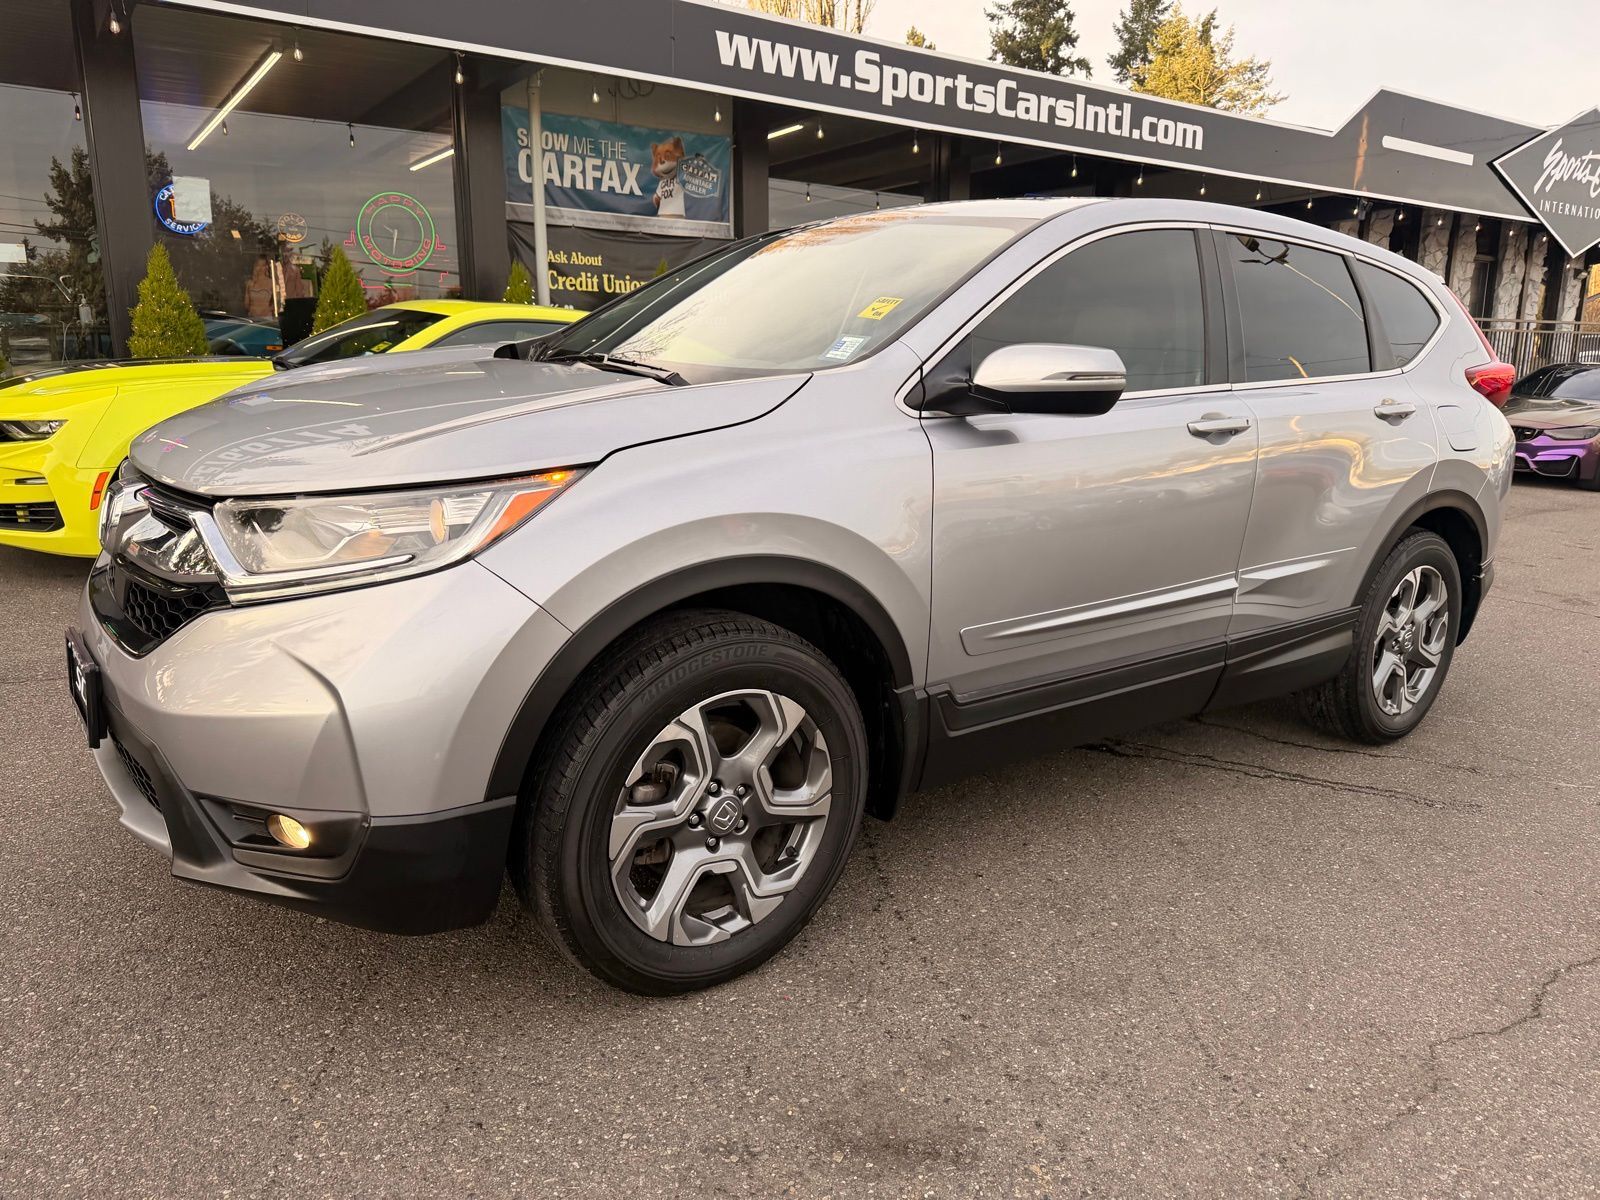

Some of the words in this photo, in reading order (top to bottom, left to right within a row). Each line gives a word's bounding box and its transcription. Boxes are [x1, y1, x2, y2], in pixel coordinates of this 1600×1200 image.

[715, 29, 1204, 150] www.SportsCarsIntl.com
[517, 128, 569, 151] SOW
[573, 137, 595, 156] ME
[599, 140, 627, 160] THE
[681, 164, 718, 182] CARFAX
[661, 189, 674, 199] FOX
[547, 250, 567, 264] Ask
[570, 252, 602, 266] About
[548, 270, 599, 291] Credit
[639, 644, 769, 706] BRIDGESTONE
